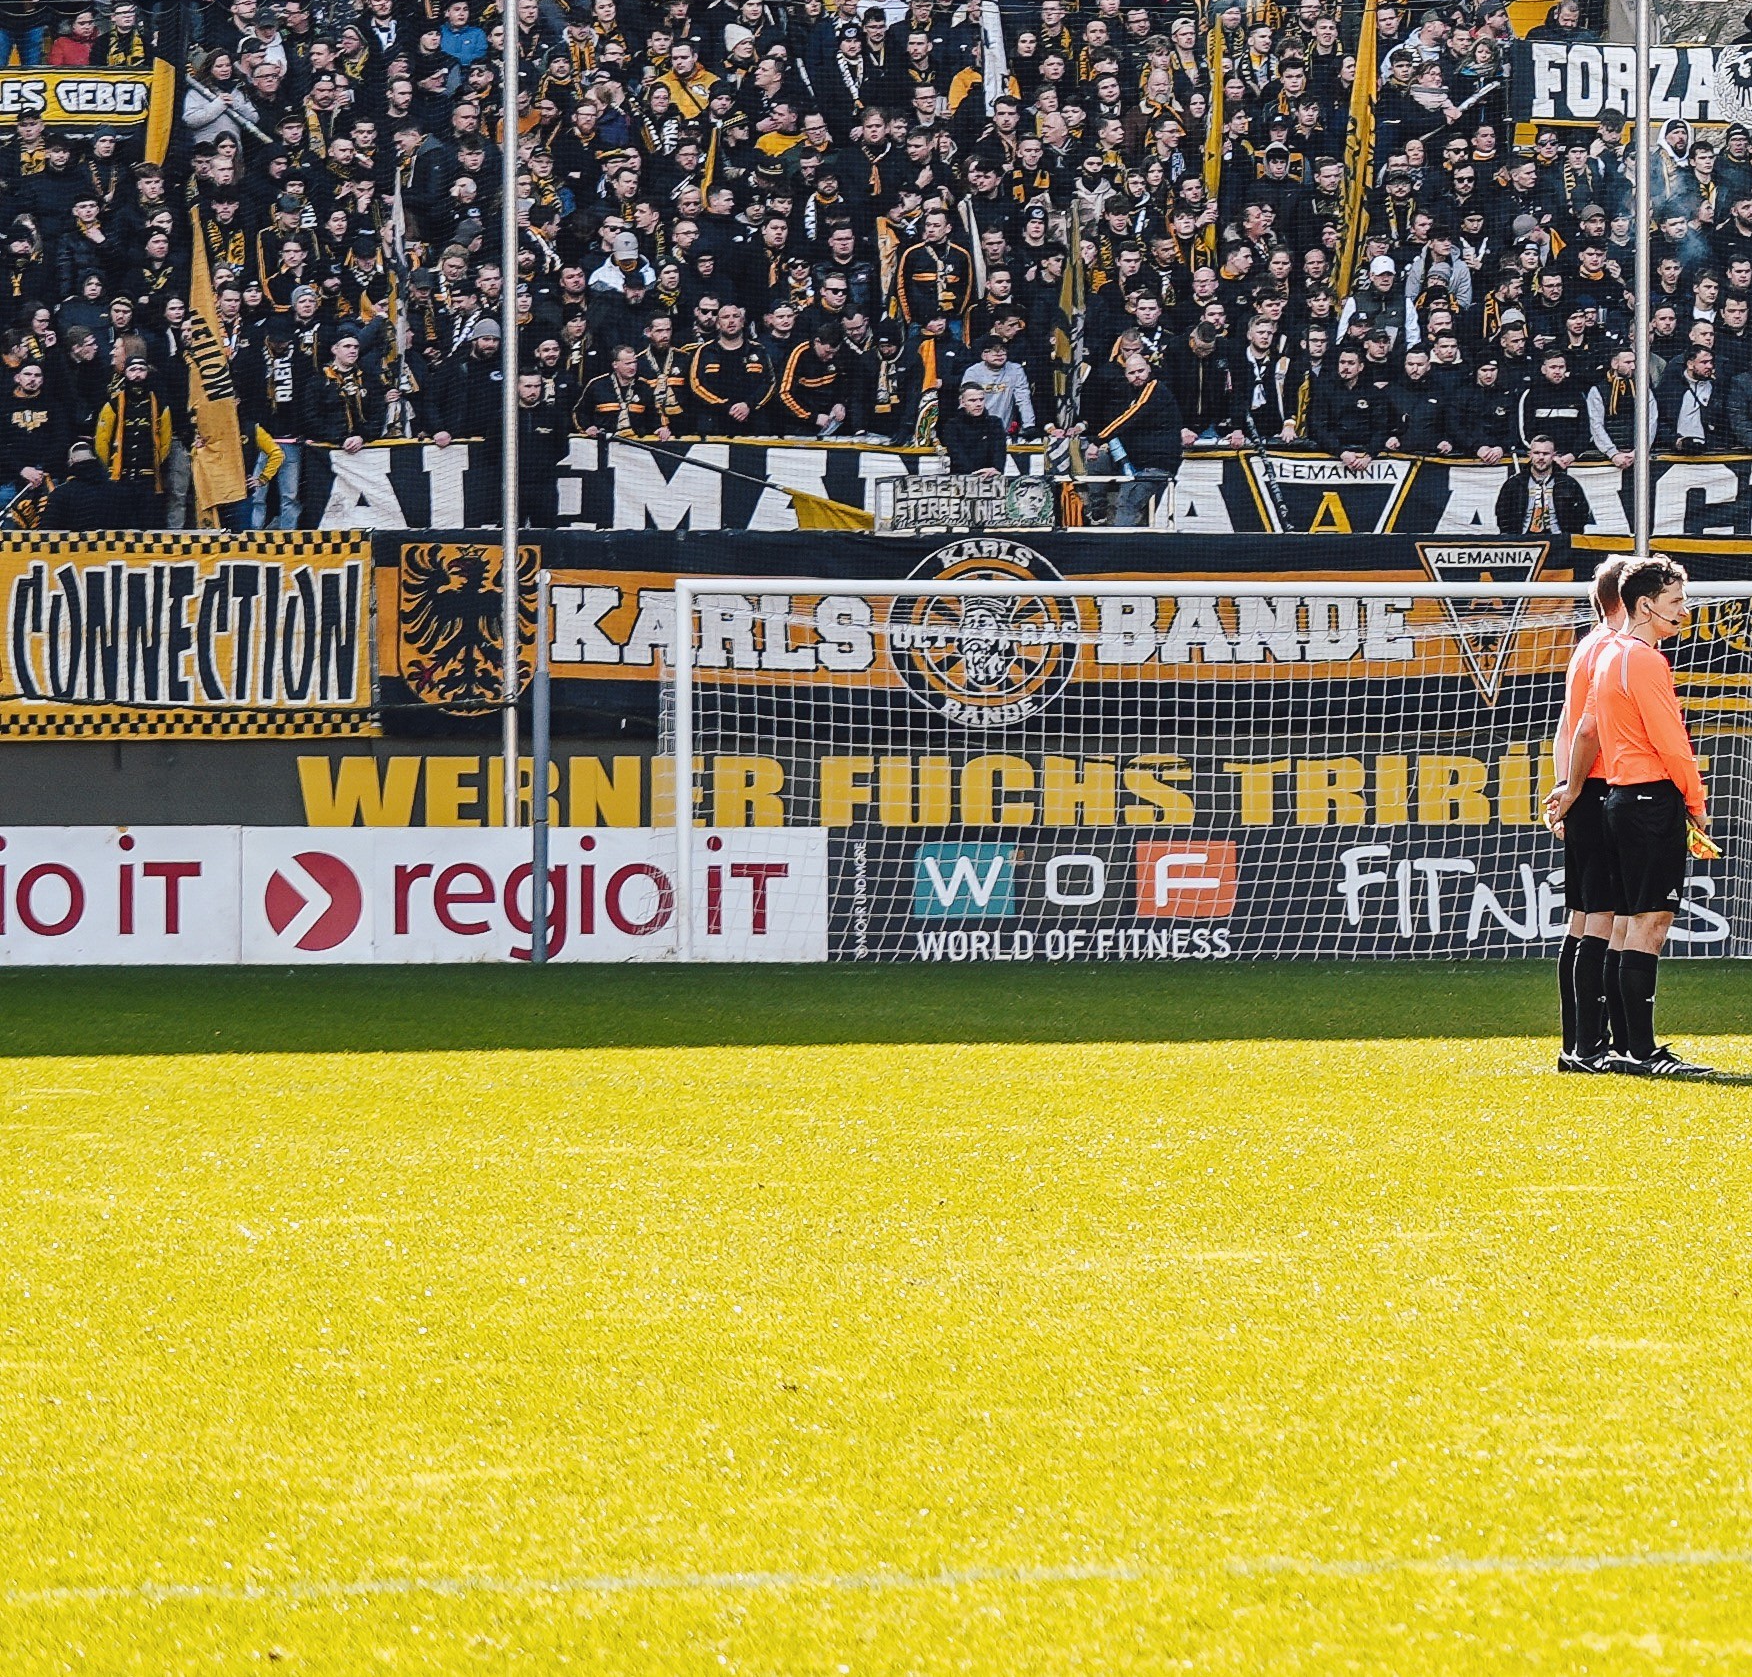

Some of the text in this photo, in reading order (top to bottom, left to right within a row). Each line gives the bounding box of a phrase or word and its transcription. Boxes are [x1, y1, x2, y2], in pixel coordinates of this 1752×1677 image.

[0, 80, 44, 114] ES
[1271, 461, 1399, 484] ALEMANNIA
[1435, 548, 1536, 568] ALEMANNIA
[10, 561, 361, 704] CONNECTION
[551, 584, 1416, 671] KARLS BANDE
[296, 742, 1568, 828] WERNER FUCHS TRIBÜ
[118, 834, 204, 935] iT
[394, 834, 789, 962] regio iT
[1339, 843, 1732, 943] FITNS
[916, 927, 1232, 960] WORLD OF FITNESS
